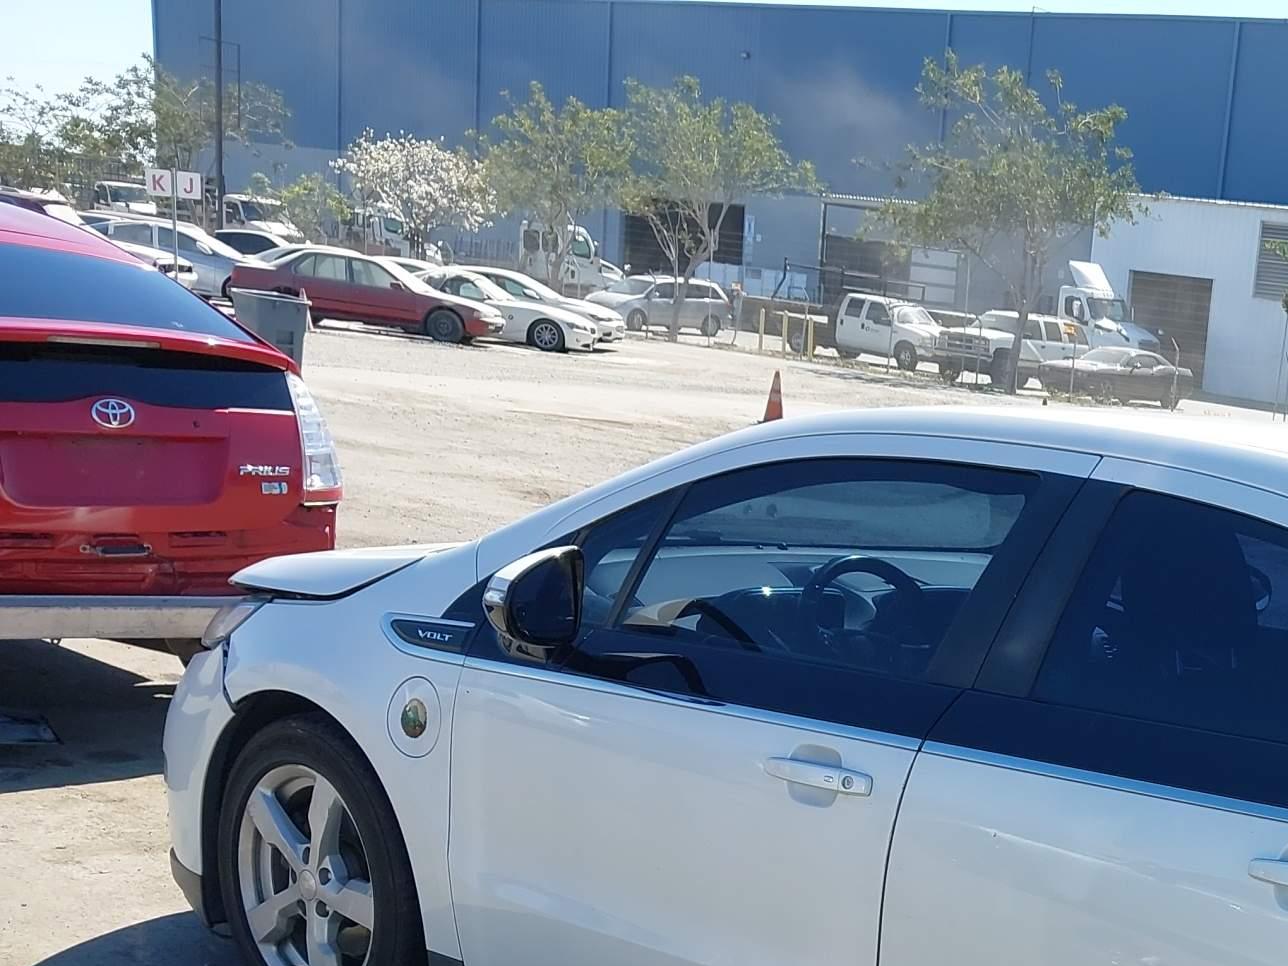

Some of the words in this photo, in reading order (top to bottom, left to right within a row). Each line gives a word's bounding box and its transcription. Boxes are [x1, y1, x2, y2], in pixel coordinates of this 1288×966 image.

[152, 174, 166, 192] K
[183, 176, 193, 194] J
[239, 464, 290, 476] PRIUS
[417, 628, 453, 641] VOLT
